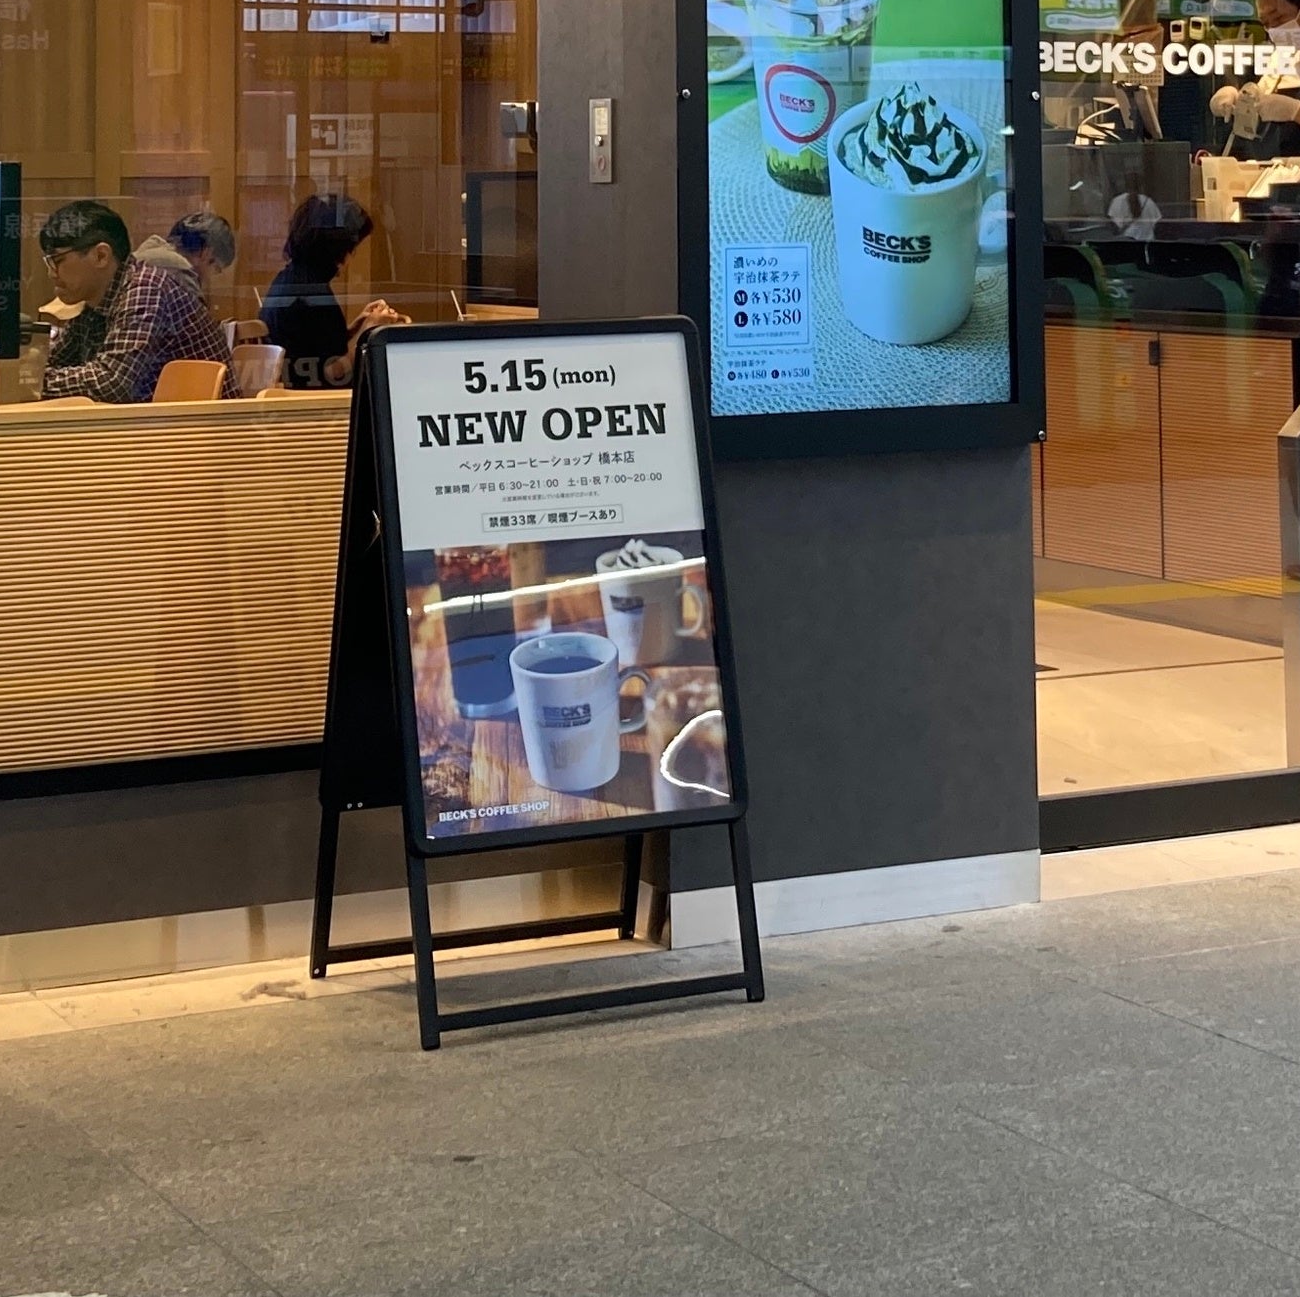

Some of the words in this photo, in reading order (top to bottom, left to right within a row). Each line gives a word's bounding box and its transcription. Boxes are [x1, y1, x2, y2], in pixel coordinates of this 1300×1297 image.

[1162, 43, 1298, 76] COFFEE
[862, 225, 932, 251] BECK'S
[733, 256, 779, 269] 濃いめの
[863, 247, 900, 264] COFFEE
[901, 254, 931, 265] SHOP
[733, 270, 801, 285] 宇治抹茶ラテ
[463, 359, 547, 395] 5.15
[552, 364, 616, 389] (mon)
[417, 410, 527, 448] NEW
[541, 402, 667, 441] OPEN
[459, 453, 593, 472] ベックスコーヒーショップ
[598, 450, 636, 465] 橋本店
[477, 803, 520, 818] COFFEE
[520, 800, 550, 813] SHOP
